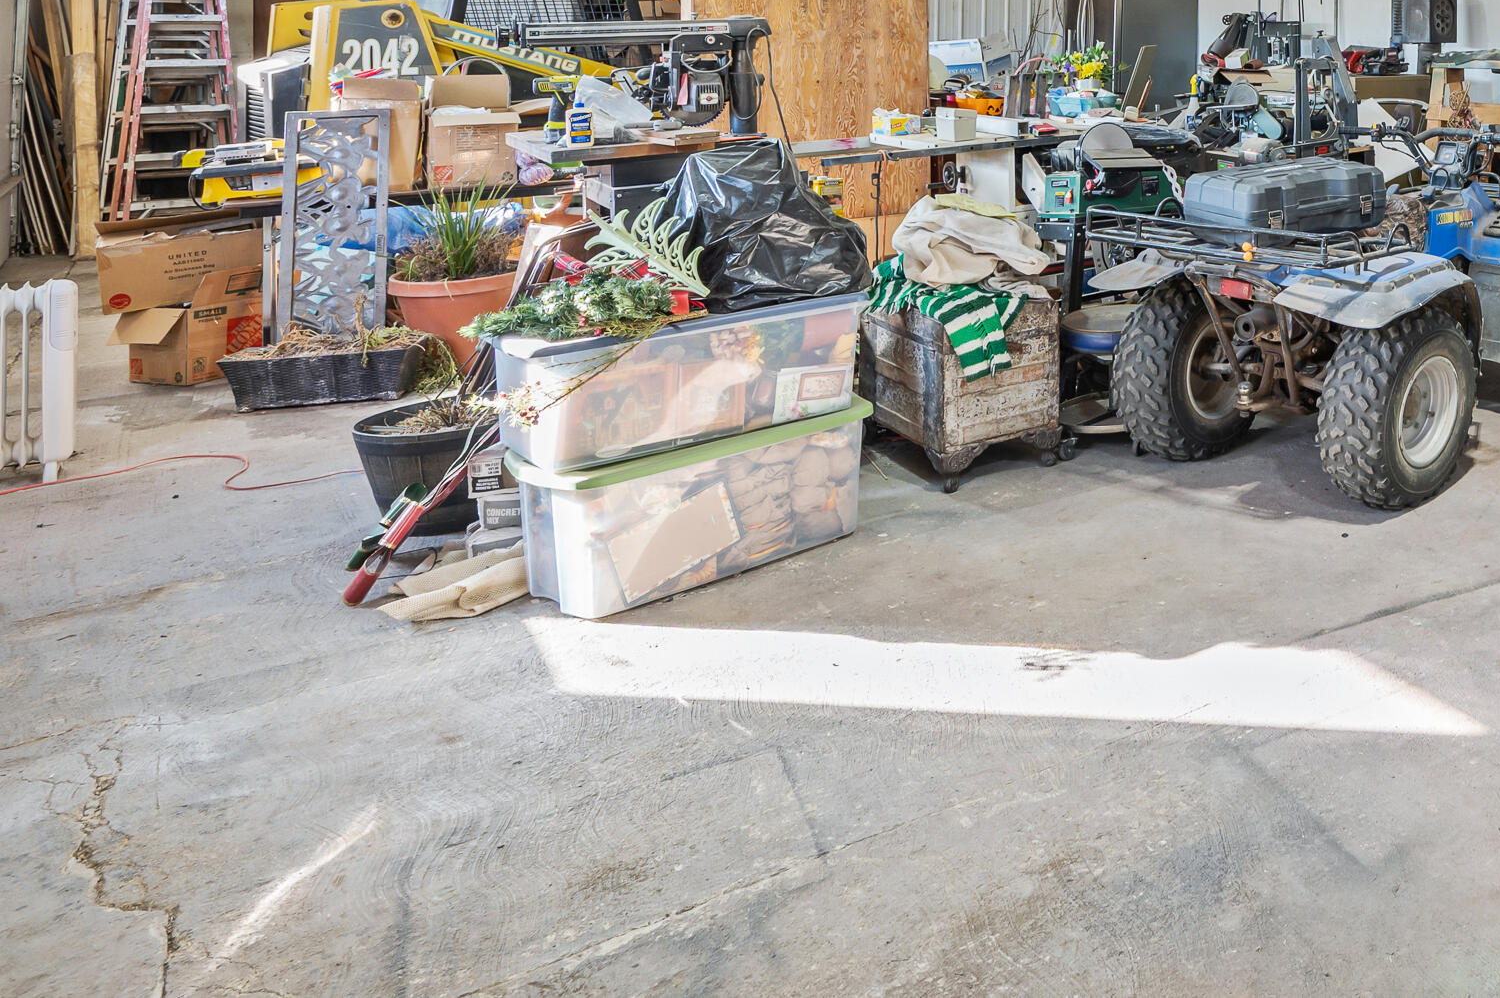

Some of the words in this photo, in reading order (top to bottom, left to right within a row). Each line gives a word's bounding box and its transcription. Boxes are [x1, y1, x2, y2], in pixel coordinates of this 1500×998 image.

[342, 38, 420, 76] 2042
[168, 250, 207, 260] UNITED
[486, 507, 520, 516] CONCRET
[486, 517, 500, 525] MIX
